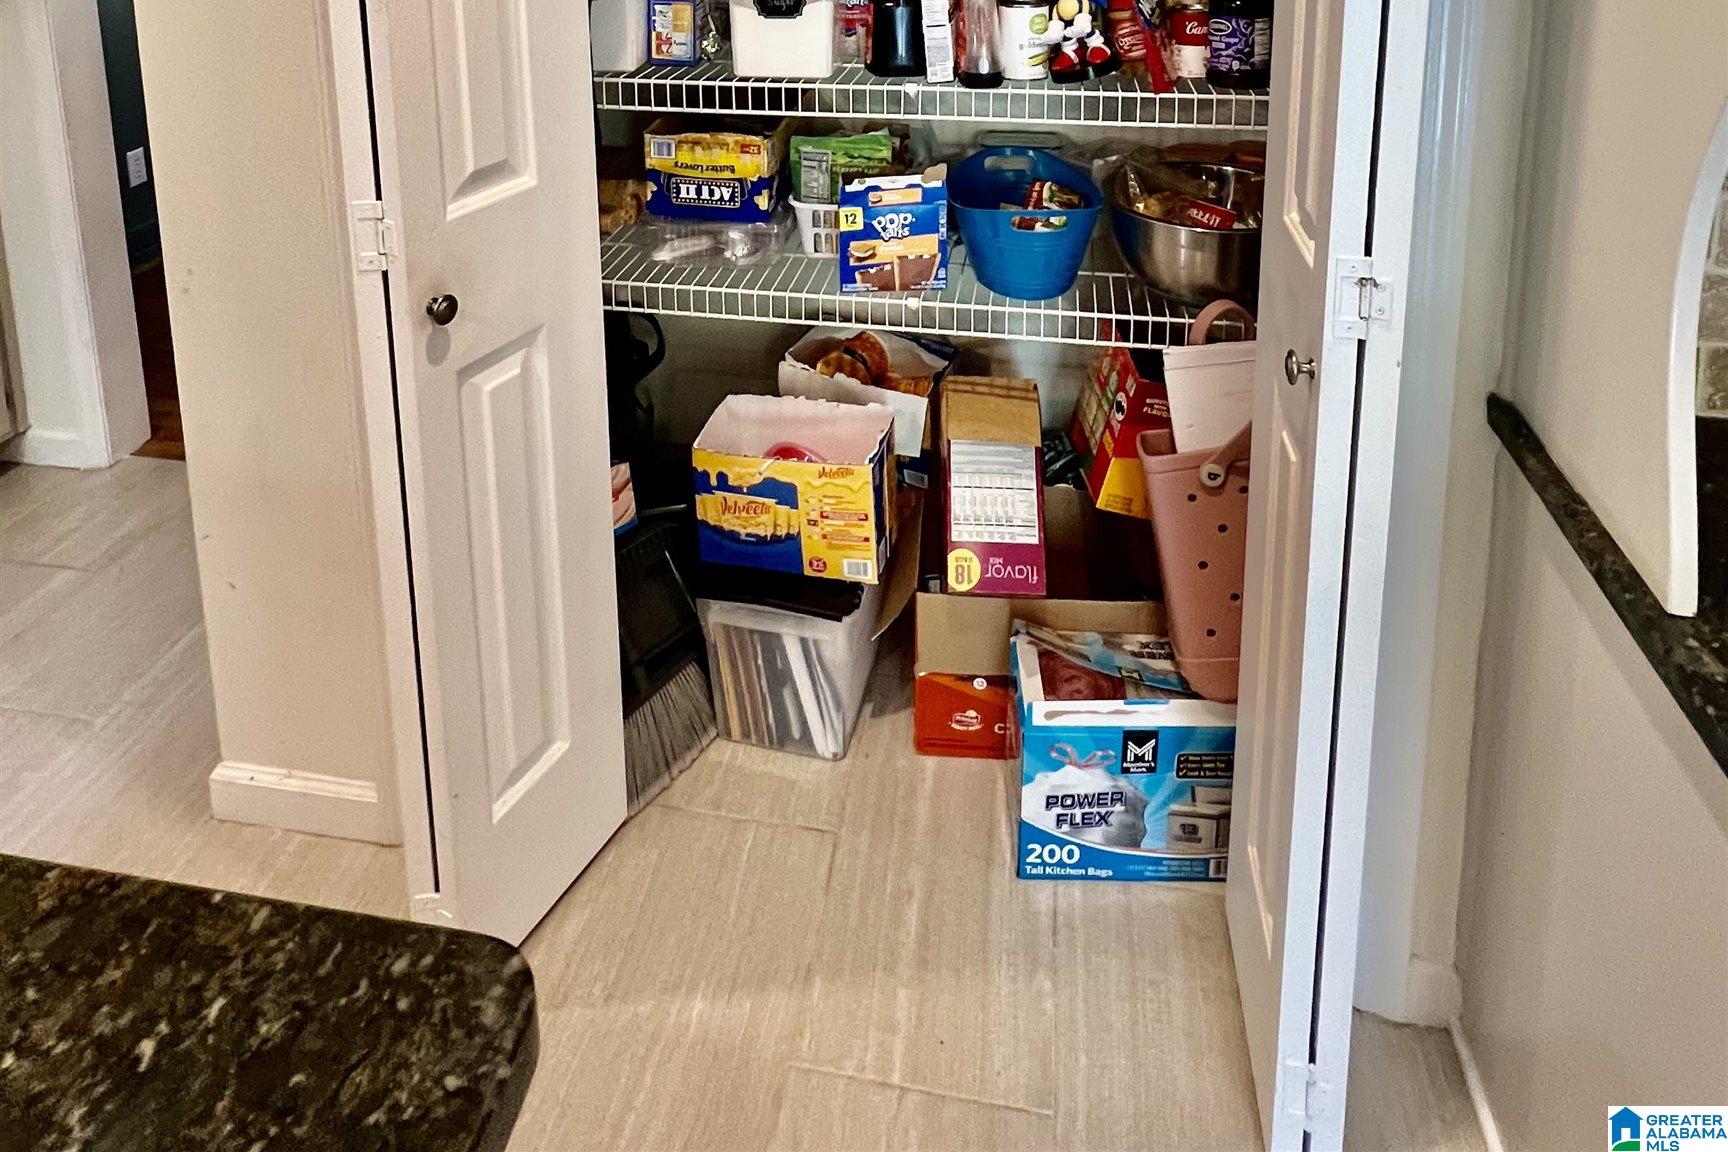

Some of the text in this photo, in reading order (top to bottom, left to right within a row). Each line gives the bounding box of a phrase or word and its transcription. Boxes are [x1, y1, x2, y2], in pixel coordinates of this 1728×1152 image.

[674, 160, 735, 174] Butter Lovers
[678, 183, 733, 201] ACT II
[844, 213, 857, 225] 12
[818, 466, 855, 479] Velveeta
[720, 496, 772, 515] Velveeta
[954, 564, 973, 585] 18
[984, 563, 1039, 584] flavor
[1045, 791, 1126, 811] POWER
[1056, 811, 1114, 829] FLEX
[1025, 843, 1081, 864] 200
[1025, 865, 1114, 878] Tall Kitchen Bags
